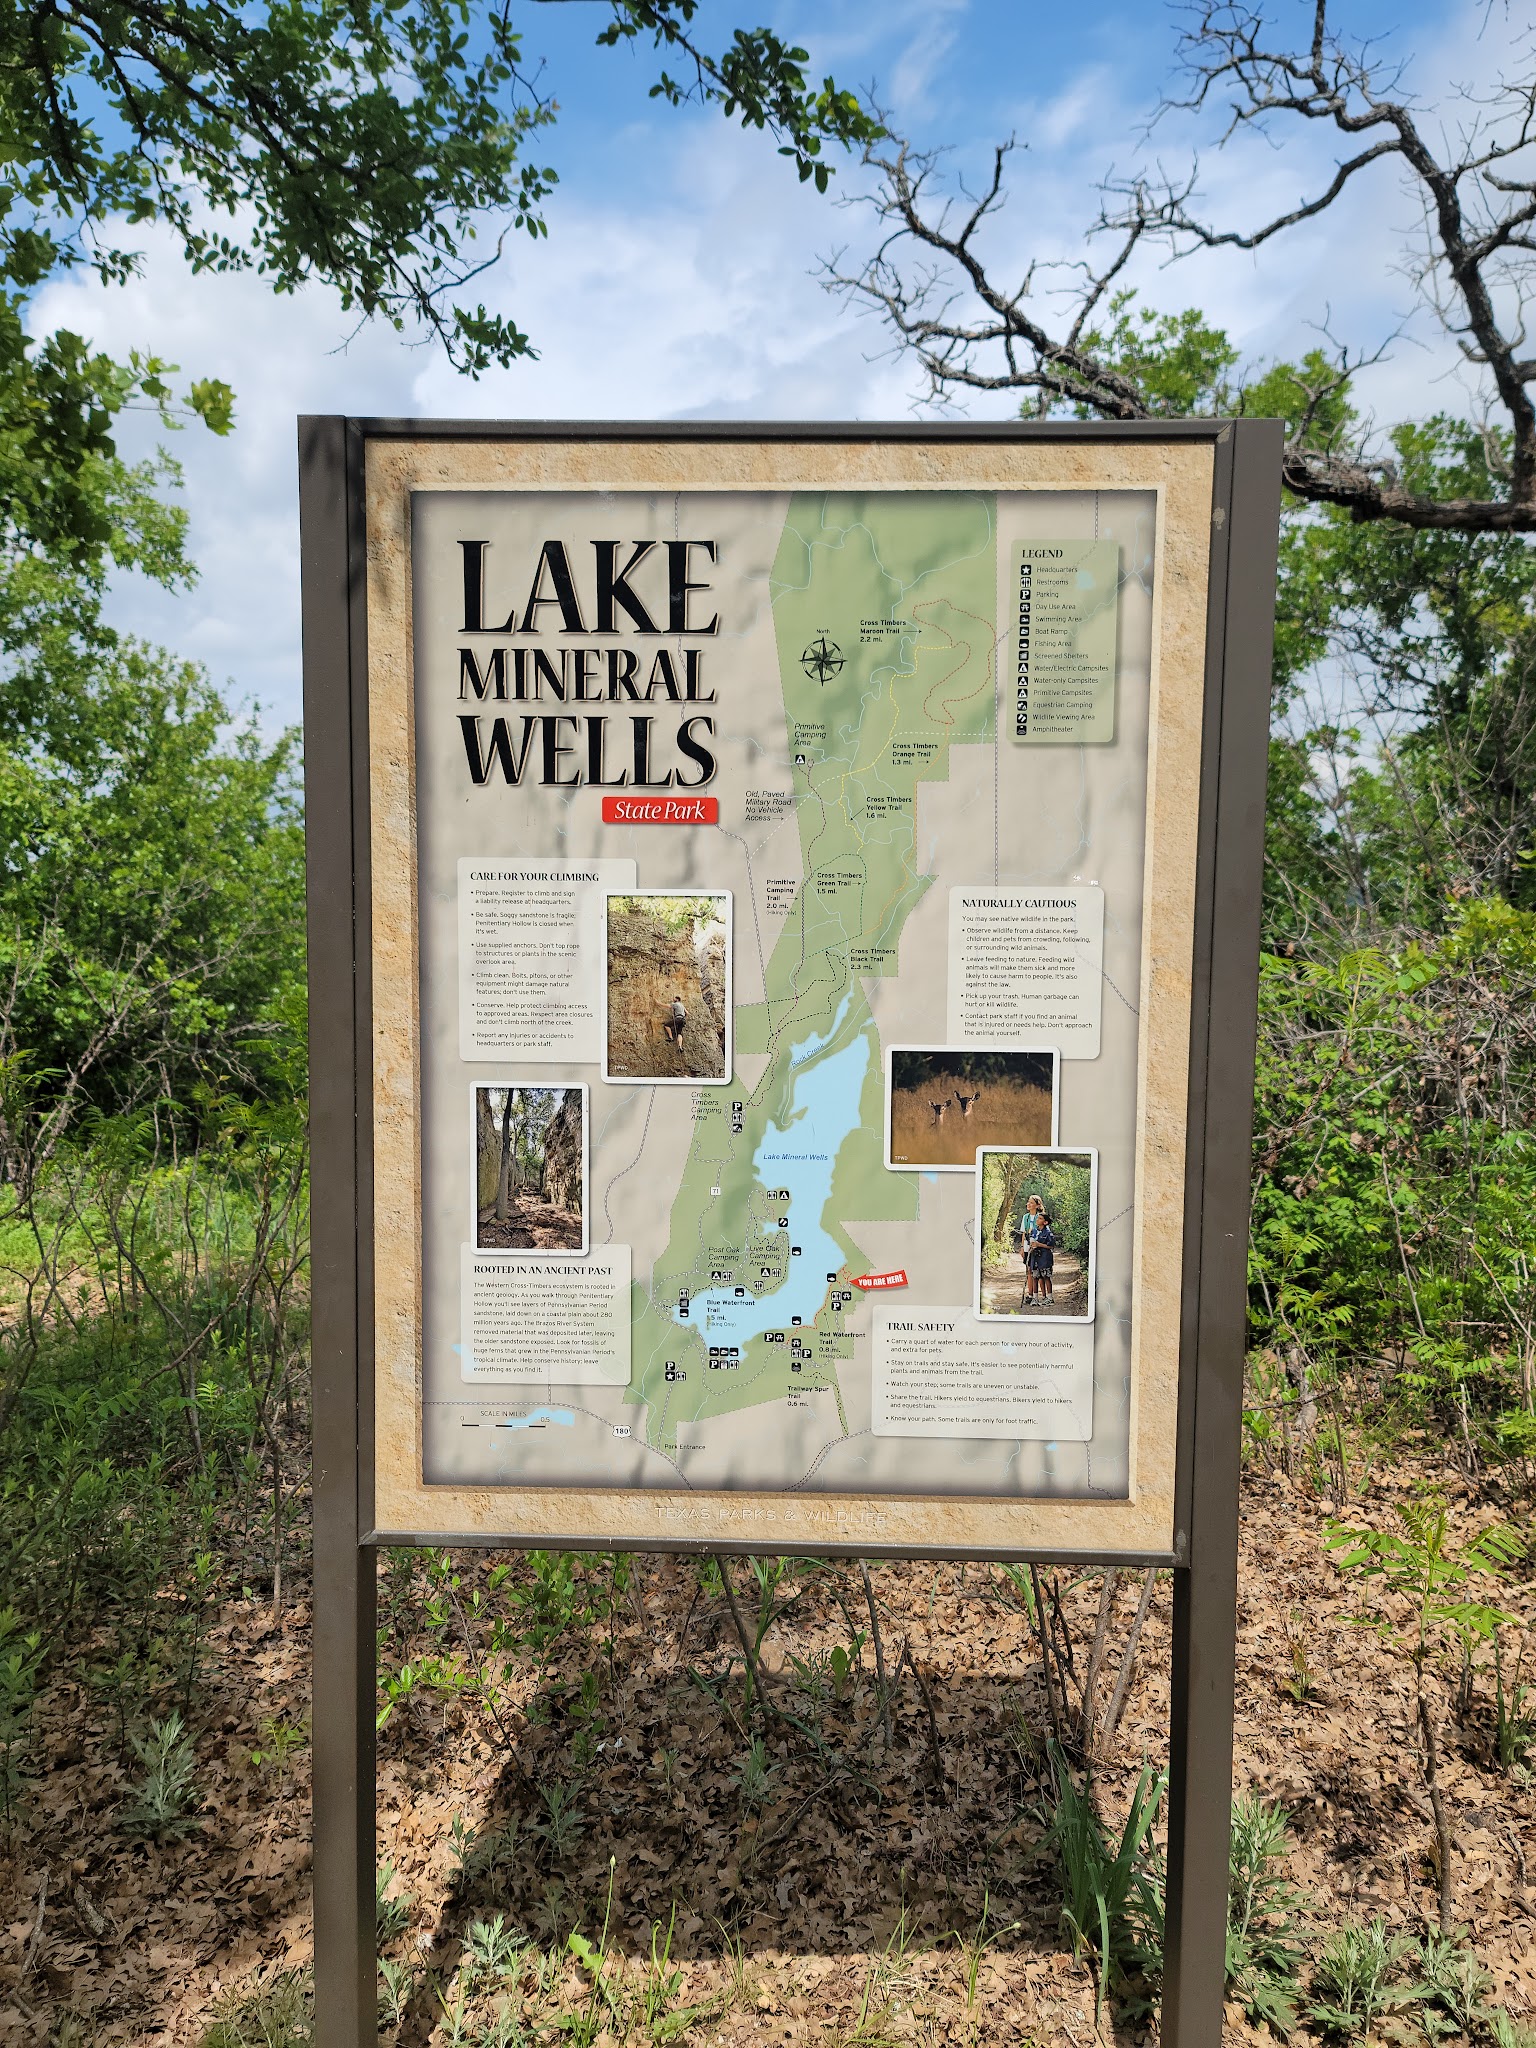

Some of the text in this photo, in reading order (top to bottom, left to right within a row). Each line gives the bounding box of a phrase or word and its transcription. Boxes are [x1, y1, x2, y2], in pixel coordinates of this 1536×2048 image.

[1022, 549, 1063, 558] LEGEND
[457, 541, 718, 635] LAKE
[457, 649, 715, 701] MINERAL
[457, 716, 716, 786] WELLS
[615, 801, 705, 819] State Park
[470, 872, 599, 881] CARE FOR YOUR CLIMBING
[962, 899, 1077, 908] NATURALLY CAUTIOUS
[474, 1265, 514, 1274] ROOTED
[528, 1266, 542, 1274] AN
[543, 1266, 587, 1275] ANCIENT
[588, 1267, 613, 1275] PAST
[873, 1277, 886, 1286] ARE
[886, 1275, 903, 1285] HERE
[886, 1322, 954, 1332] TRAIL SAFETY
[655, 1508, 887, 1523] TEXAS PARKS & WILDLIFE
